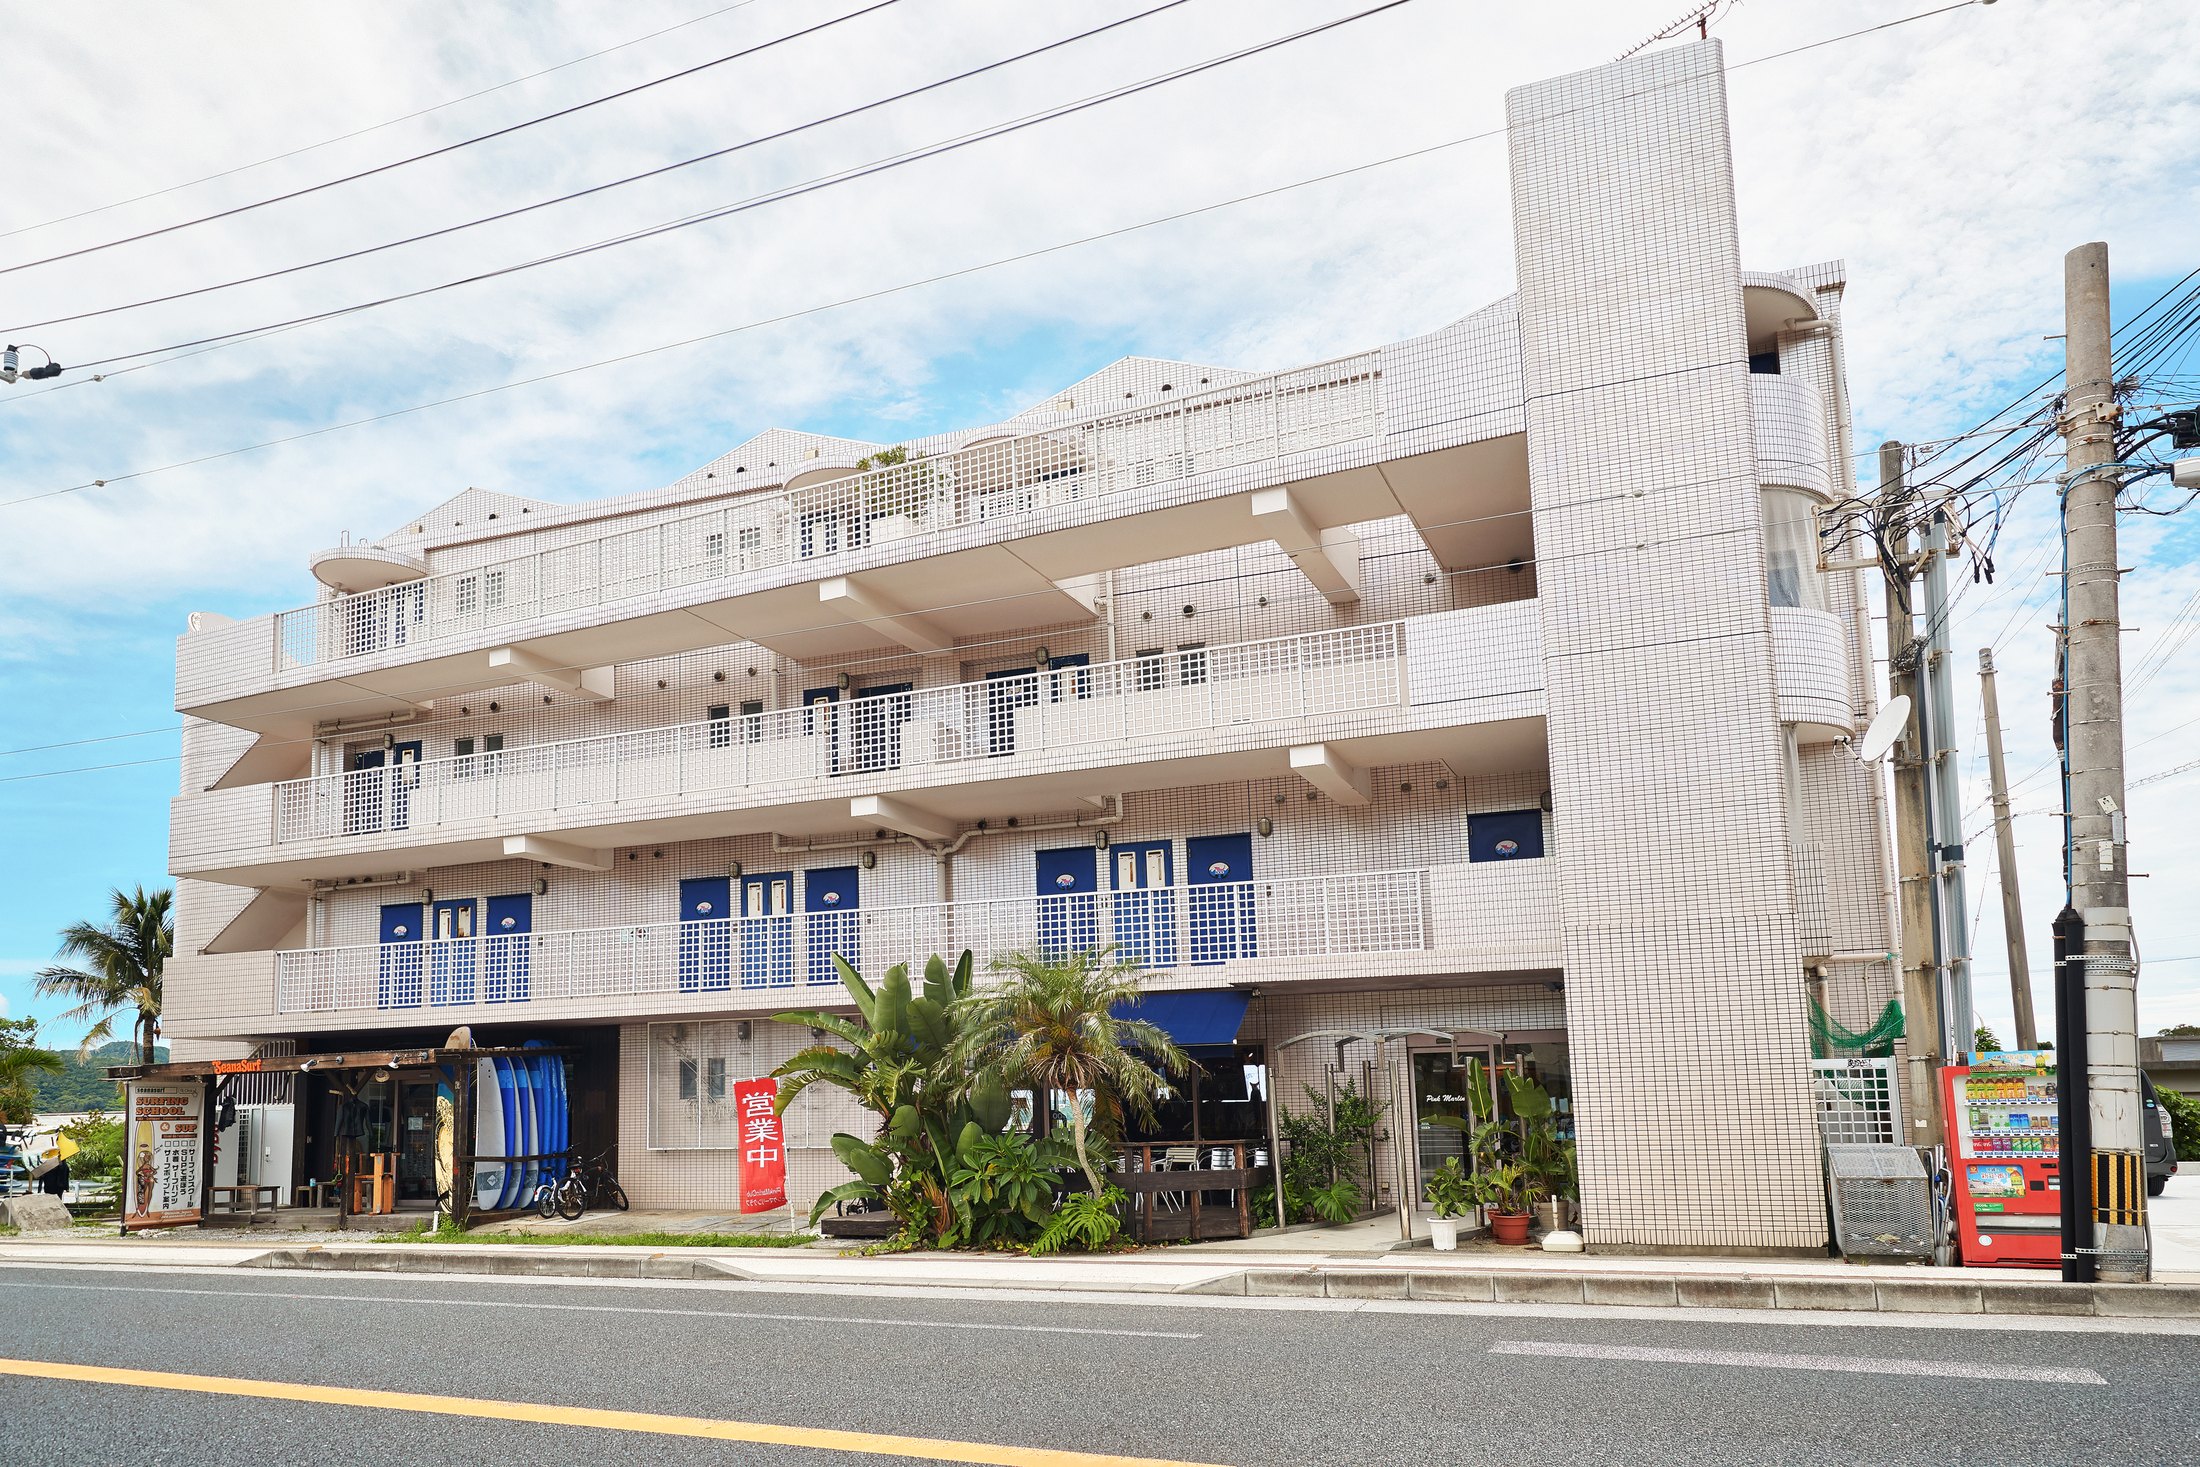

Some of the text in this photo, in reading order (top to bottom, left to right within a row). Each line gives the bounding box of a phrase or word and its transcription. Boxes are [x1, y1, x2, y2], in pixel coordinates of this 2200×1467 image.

[212, 1059, 262, 1074] SeanaSurf
[136, 1097, 188, 1106] SURFING
[136, 1107, 185, 1116] SCHOOL
[175, 1124, 198, 1133] SUP
